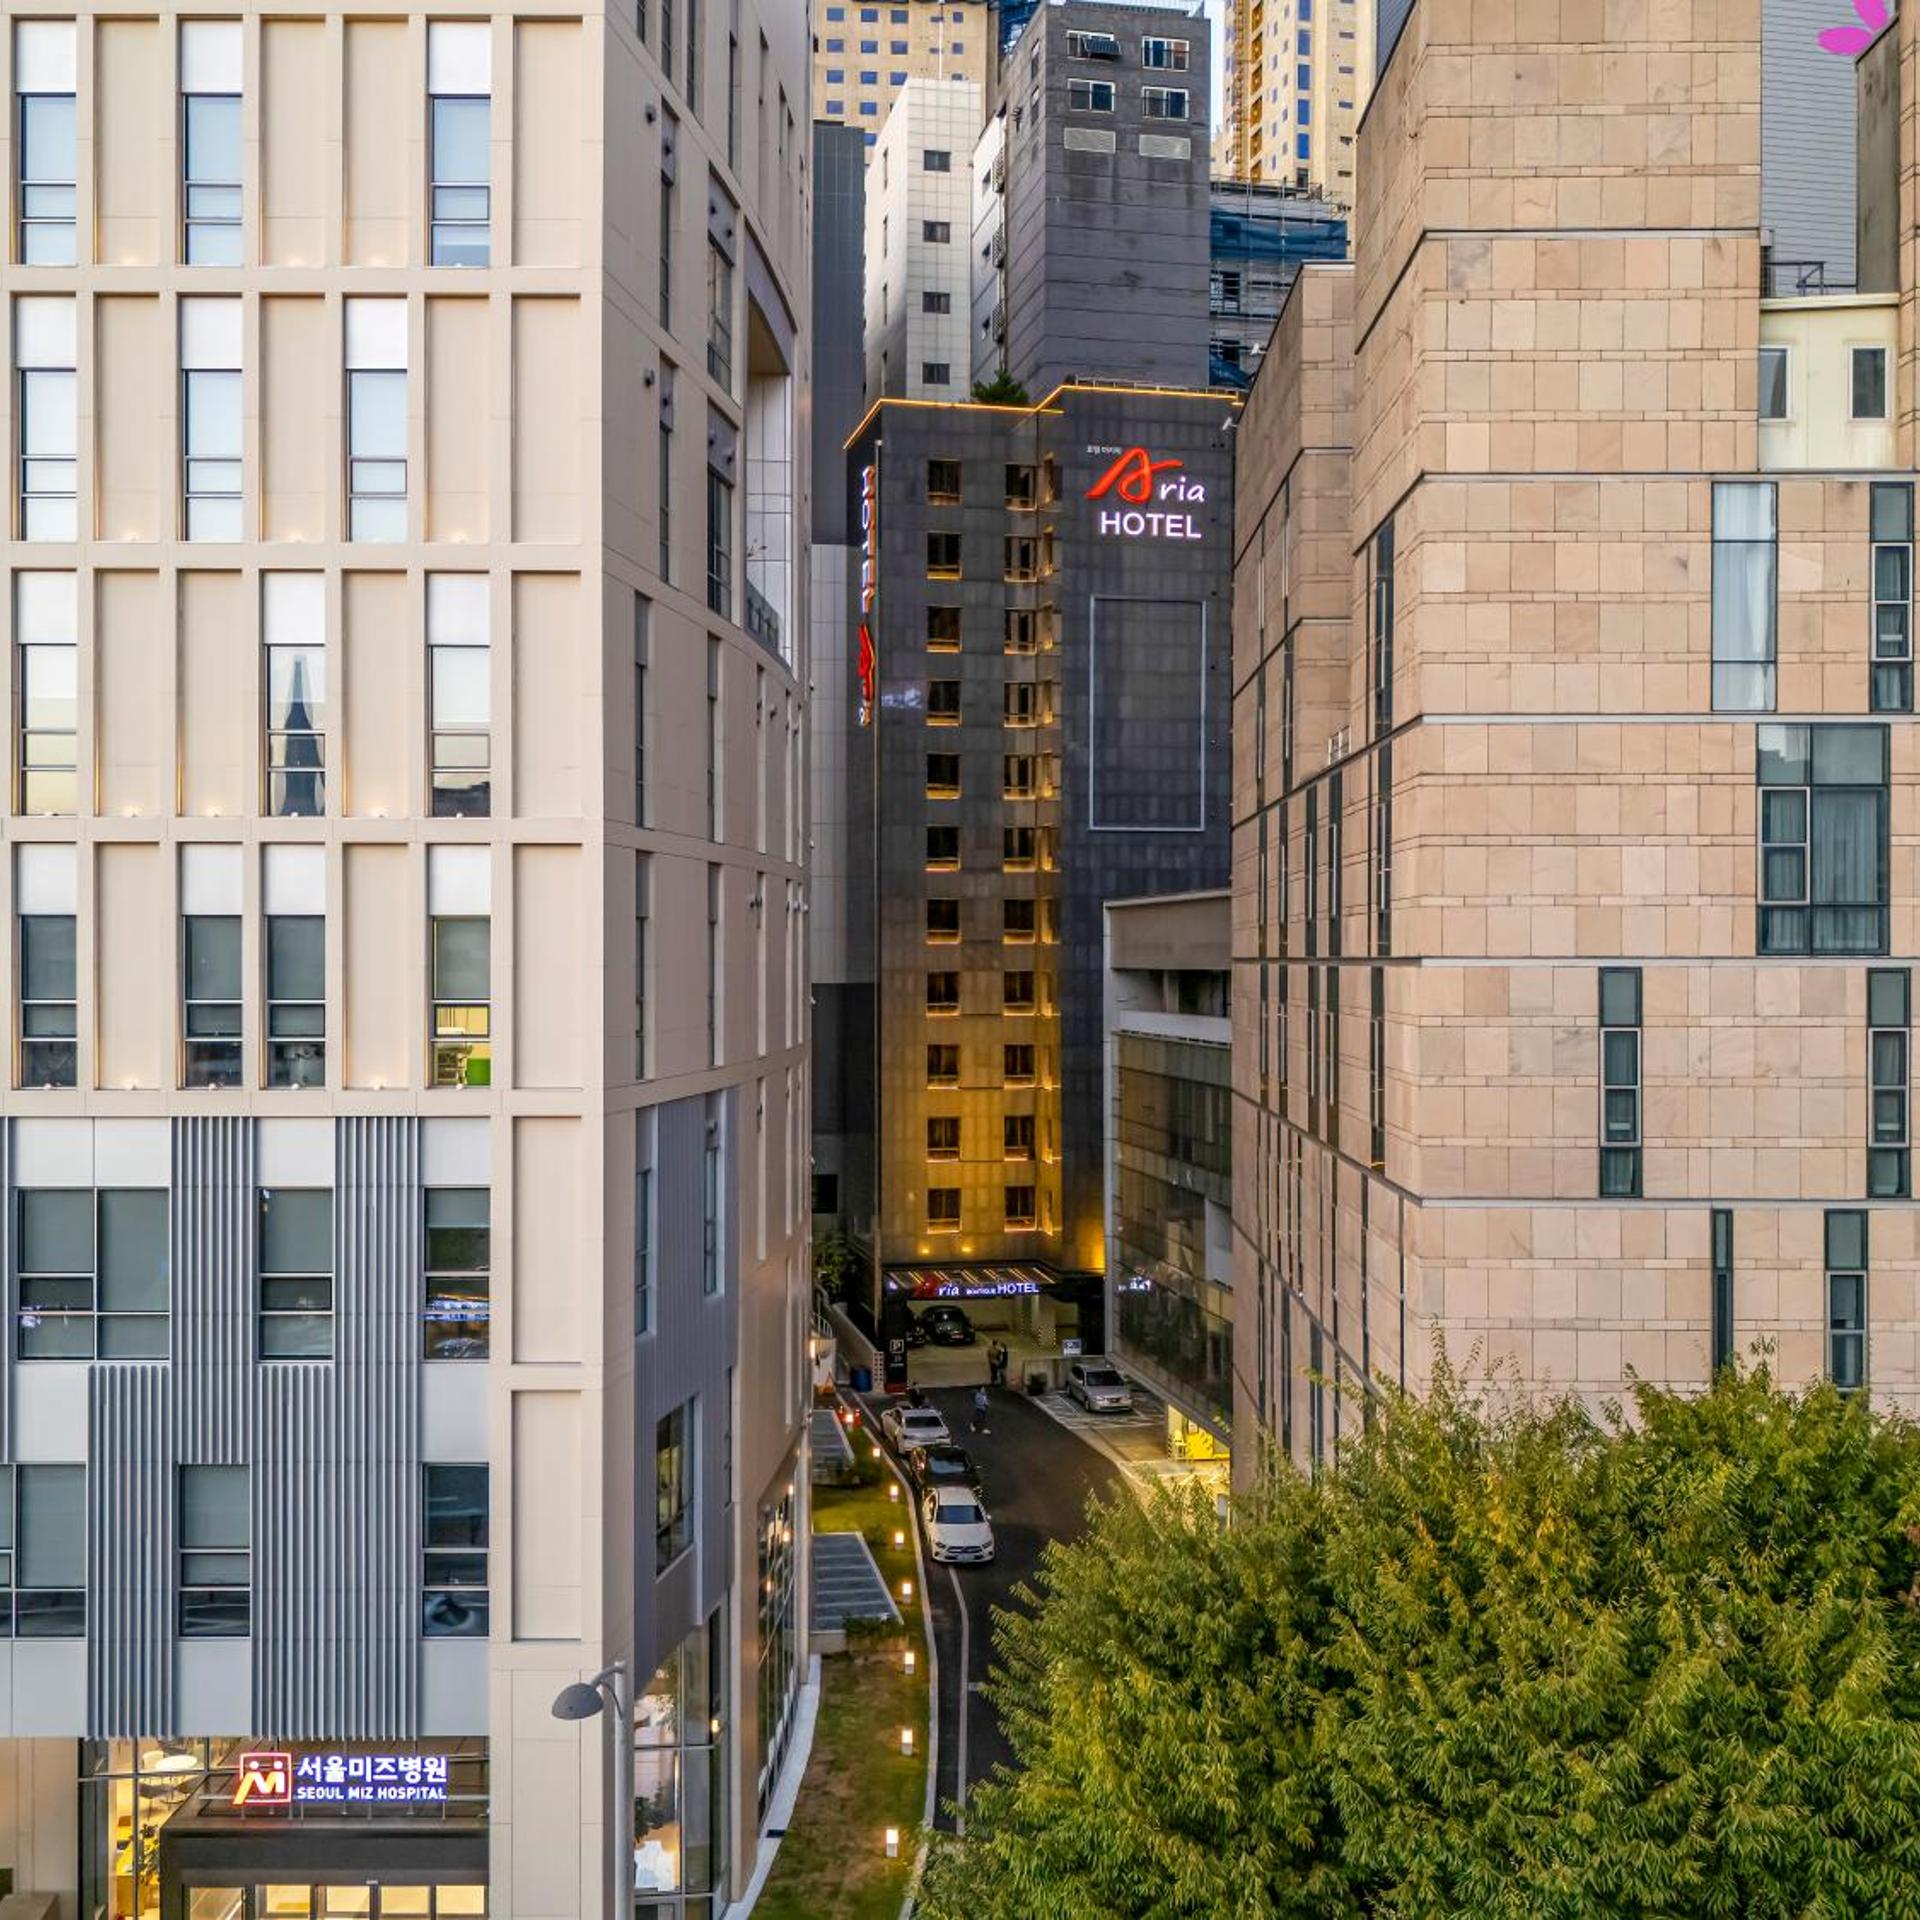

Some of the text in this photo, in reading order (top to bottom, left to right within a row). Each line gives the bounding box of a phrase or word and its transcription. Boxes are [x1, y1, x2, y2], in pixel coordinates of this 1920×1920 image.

[1083, 446, 1205, 505] Aria
[1100, 511, 1202, 538] HOTEL
[996, 1282, 1040, 1295] HOTEL
[297, 1755, 448, 1783] 서울미즈병원
[297, 1786, 447, 1800] SEOUL MIZ HOSPITAL
